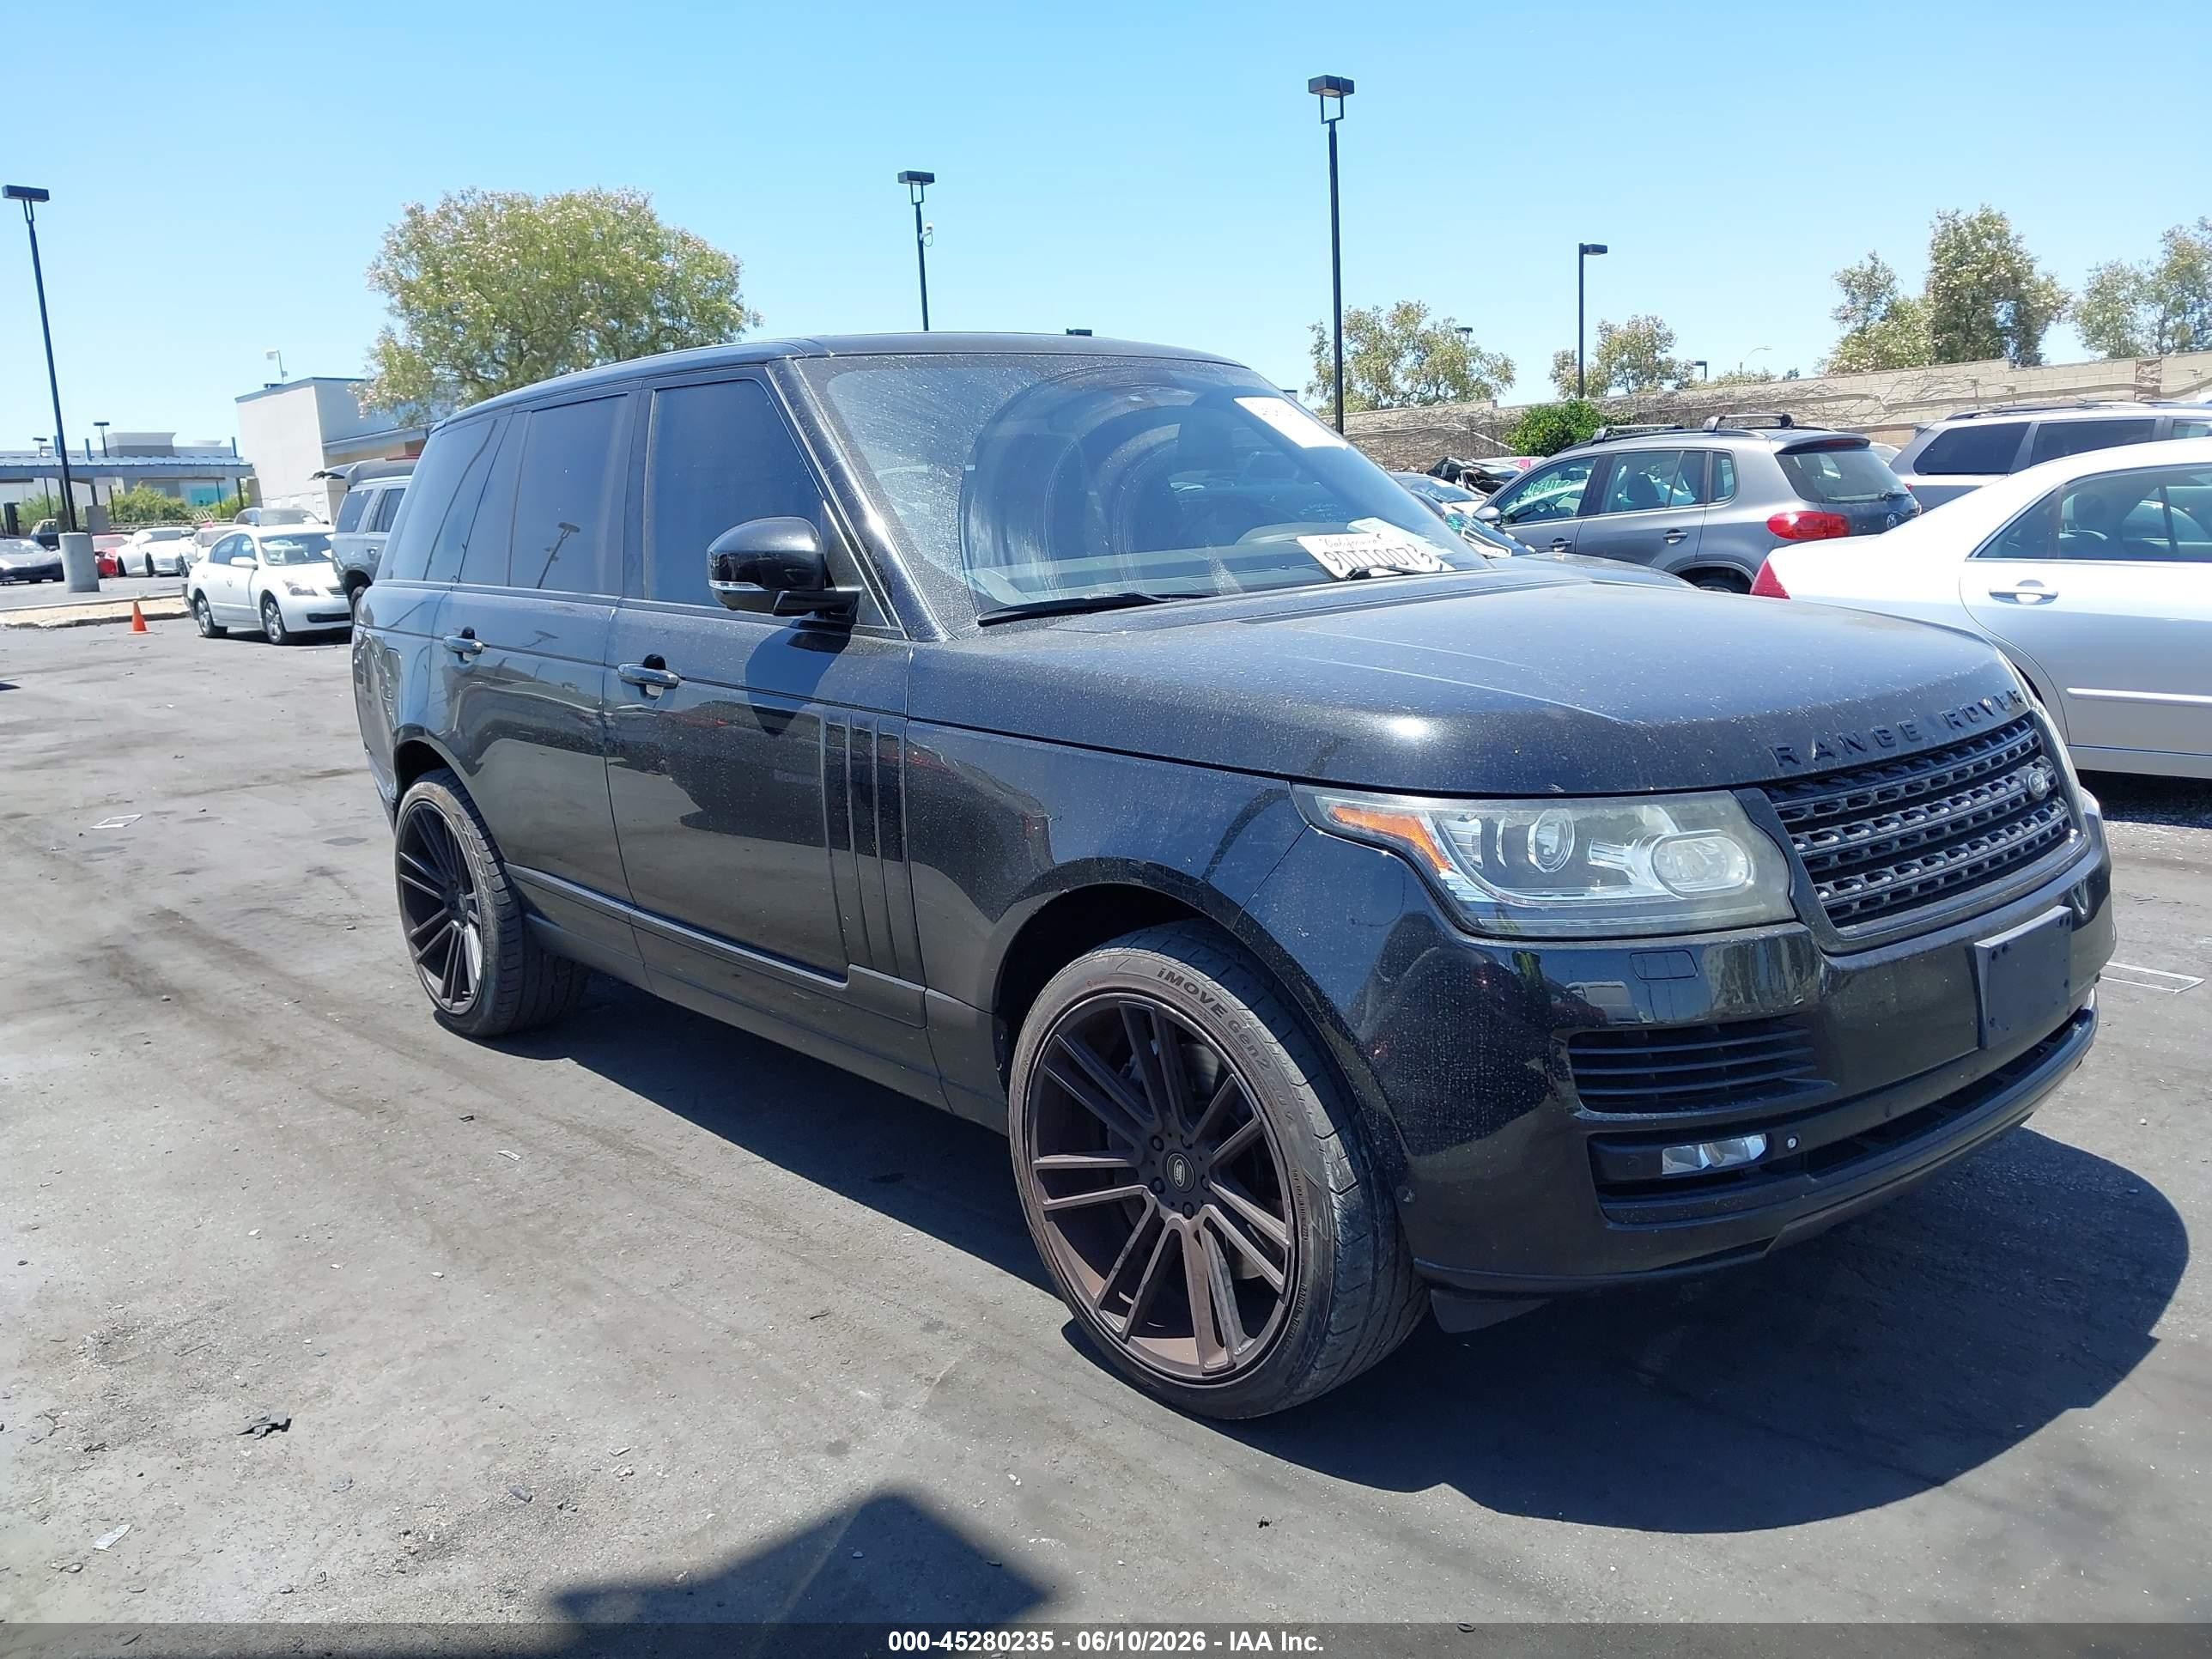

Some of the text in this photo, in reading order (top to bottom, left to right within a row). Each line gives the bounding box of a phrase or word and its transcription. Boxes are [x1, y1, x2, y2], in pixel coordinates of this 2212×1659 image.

[1769, 688, 2025, 768] RANGE ROVER
[1157, 967, 1229, 1019] iMOVE
[1227, 1018, 1272, 1073] Gen2
